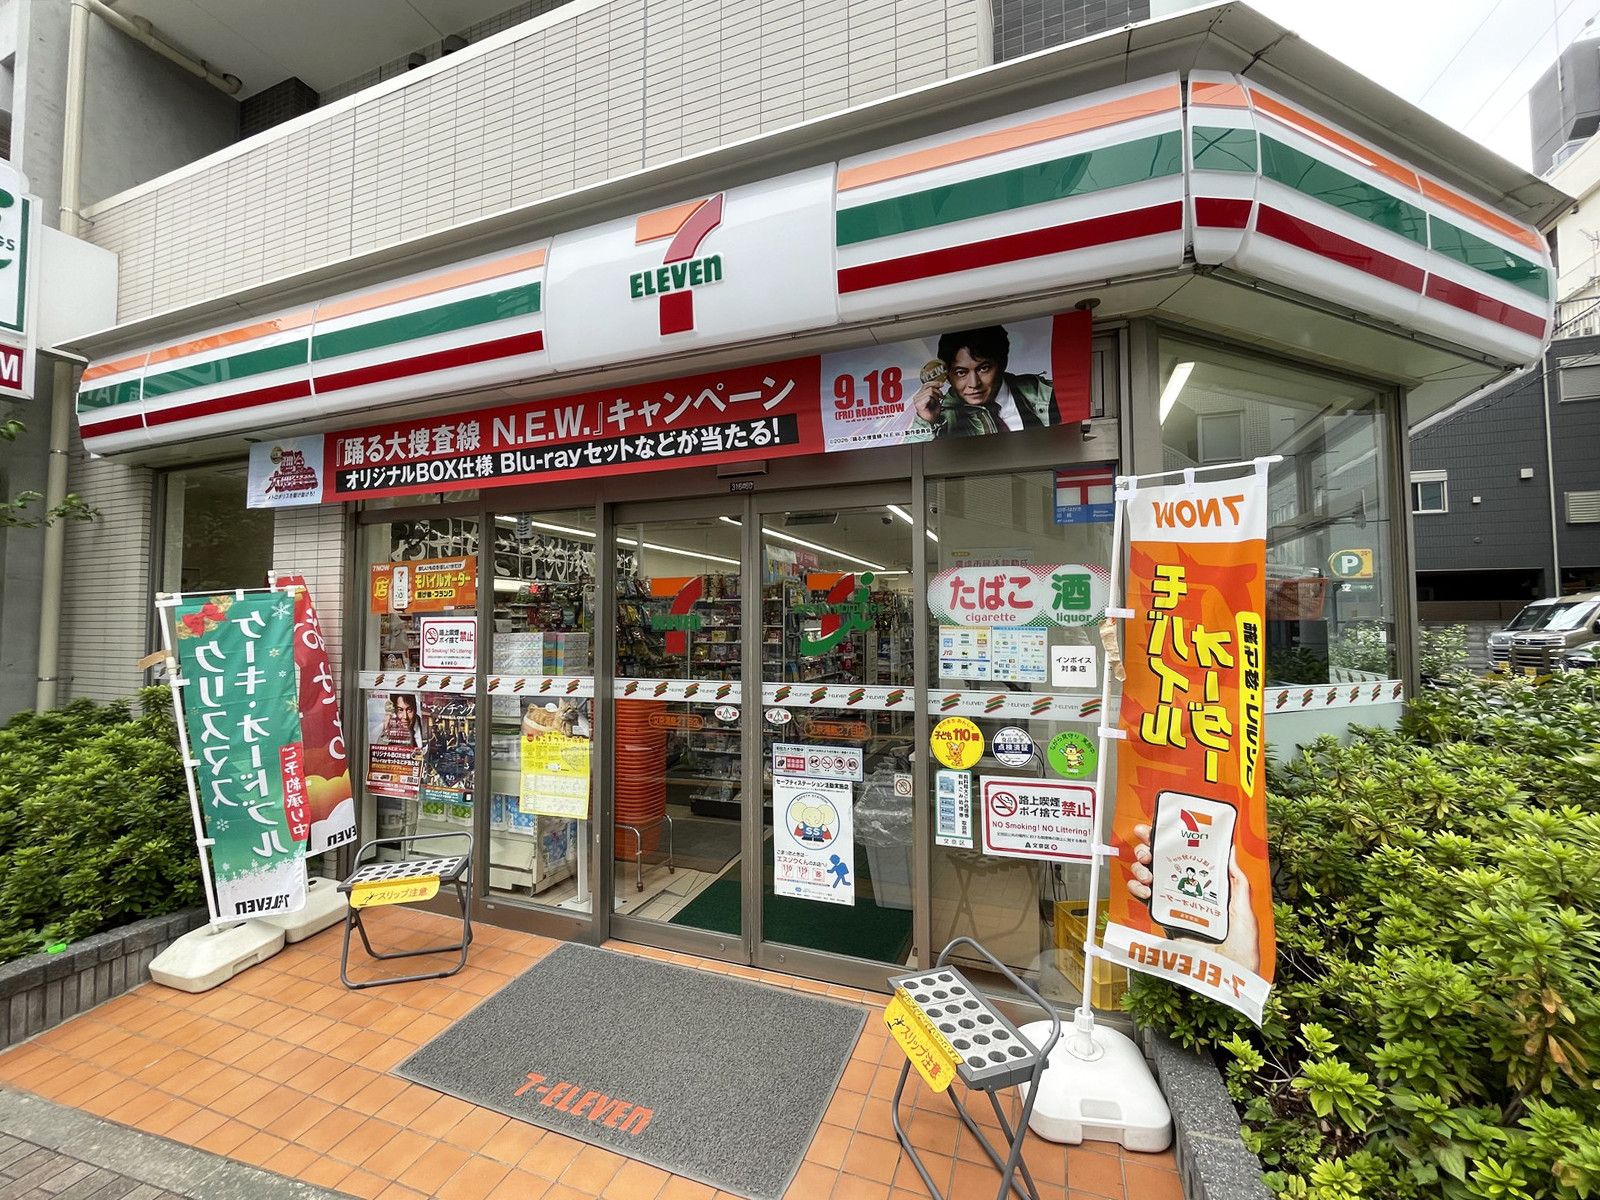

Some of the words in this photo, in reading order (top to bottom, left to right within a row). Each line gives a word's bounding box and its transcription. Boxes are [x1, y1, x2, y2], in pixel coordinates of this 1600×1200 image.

[833, 366, 903, 410] 9.18
[856, 402, 905, 418] ROADSHOW
[336, 420, 481, 467] 『踊る大捜査線
[493, 376, 796, 448] N.E.W.』キャンペーン
[345, 454, 494, 490] オリジナルBOX仕様
[1341, 555, 1359, 574] P
[415, 570, 472, 589] モバイルオーダー
[949, 573, 1034, 611] たばこ
[1051, 573, 1092, 611] 酒
[965, 612, 1016, 624] cigarette
[1056, 612, 1093, 624] liquor
[1055, 656, 1092, 664] インボイス
[1061, 665, 1087, 673] 対象店
[1018, 795, 1061, 807] 路上喫煙
[1019, 806, 1061, 819] ポイ捨て
[1061, 800, 1092, 819] 禁止
[805, 826, 821, 837] SS
[992, 820, 1003, 830] NO
[1005, 821, 1041, 833] Smoking!
[1041, 824, 1054, 833] NO
[1055, 825, 1091, 836] Littering!
[378, 887, 429, 901] スリップ注意
[900, 1025, 942, 1081] スリップ注意
